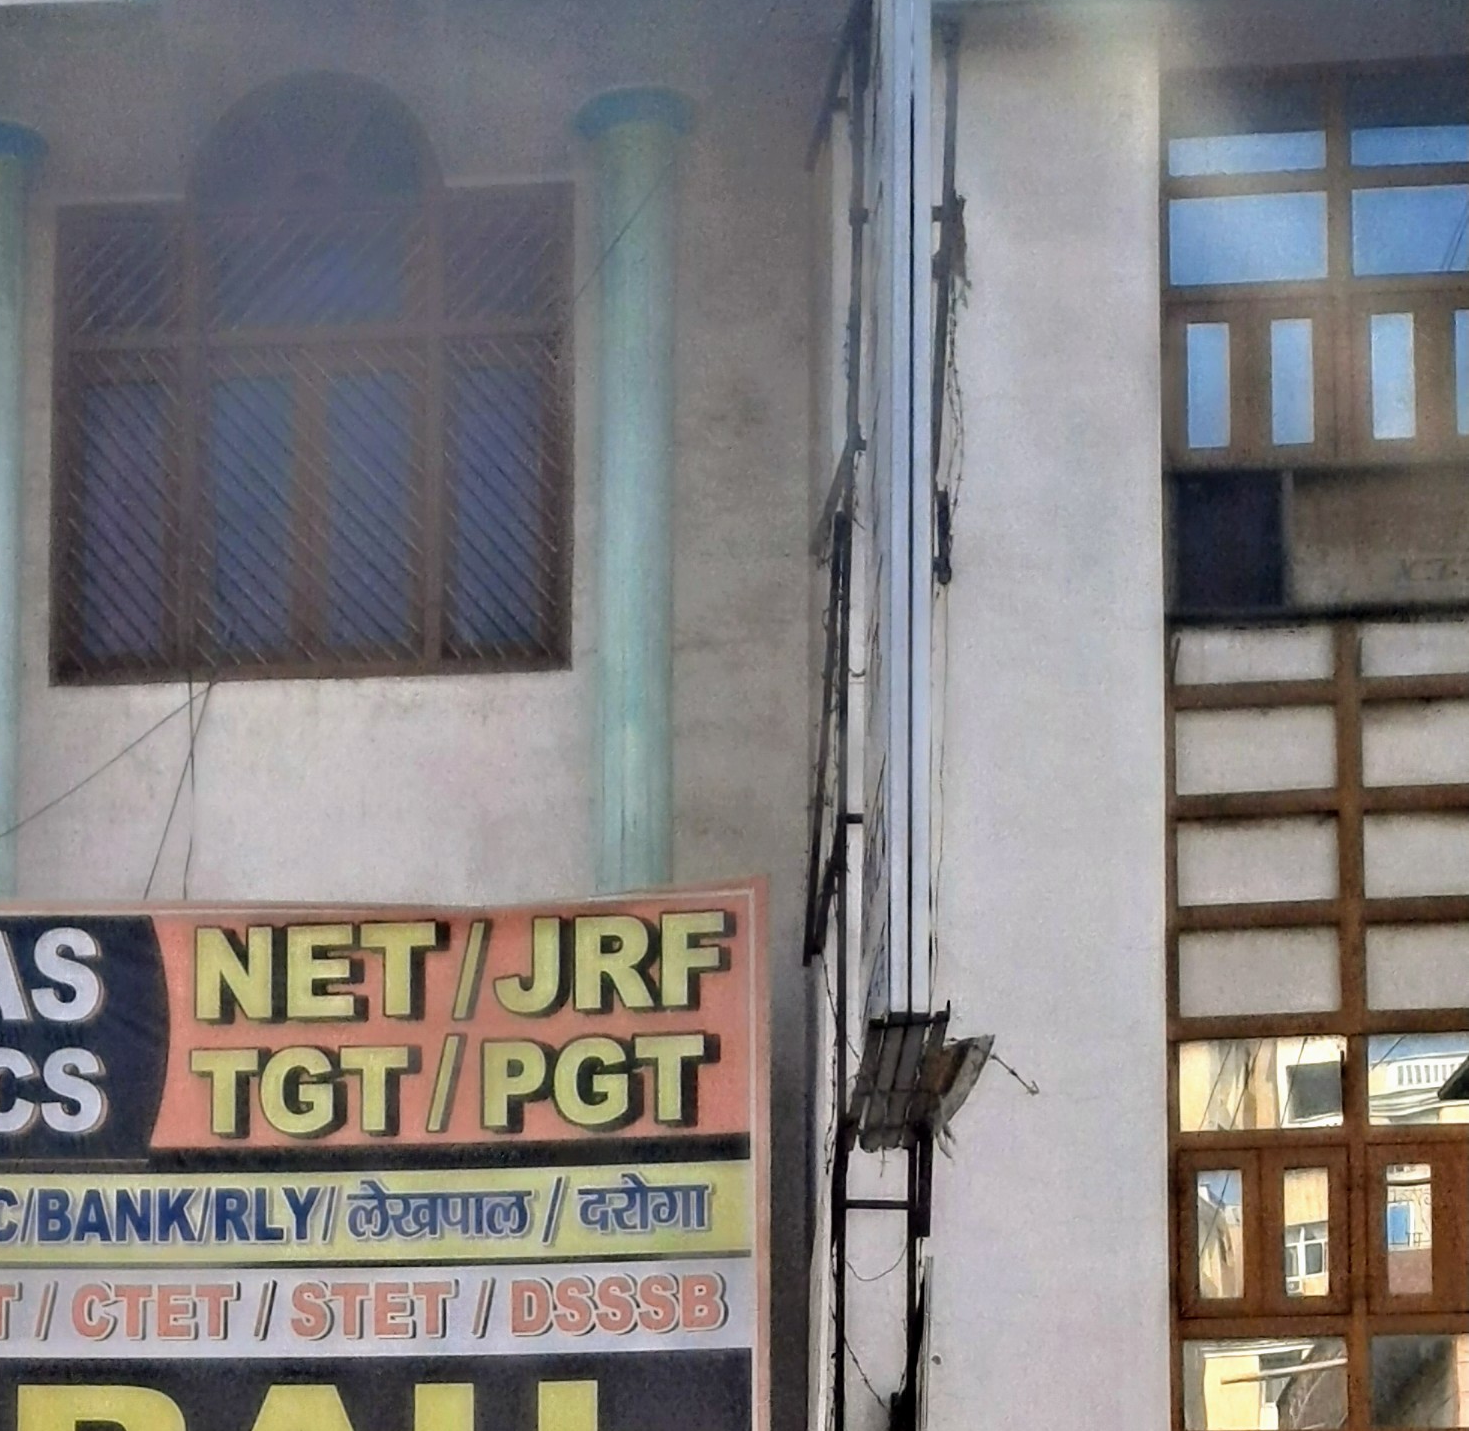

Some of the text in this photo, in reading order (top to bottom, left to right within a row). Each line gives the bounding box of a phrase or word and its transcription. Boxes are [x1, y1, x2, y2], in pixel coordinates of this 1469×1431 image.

[578, 1172, 717, 1233] दरोगा
[71, 1282, 241, 1340] CTET
[290, 1280, 459, 1339] STET
[510, 1274, 728, 1336] DSSSB
